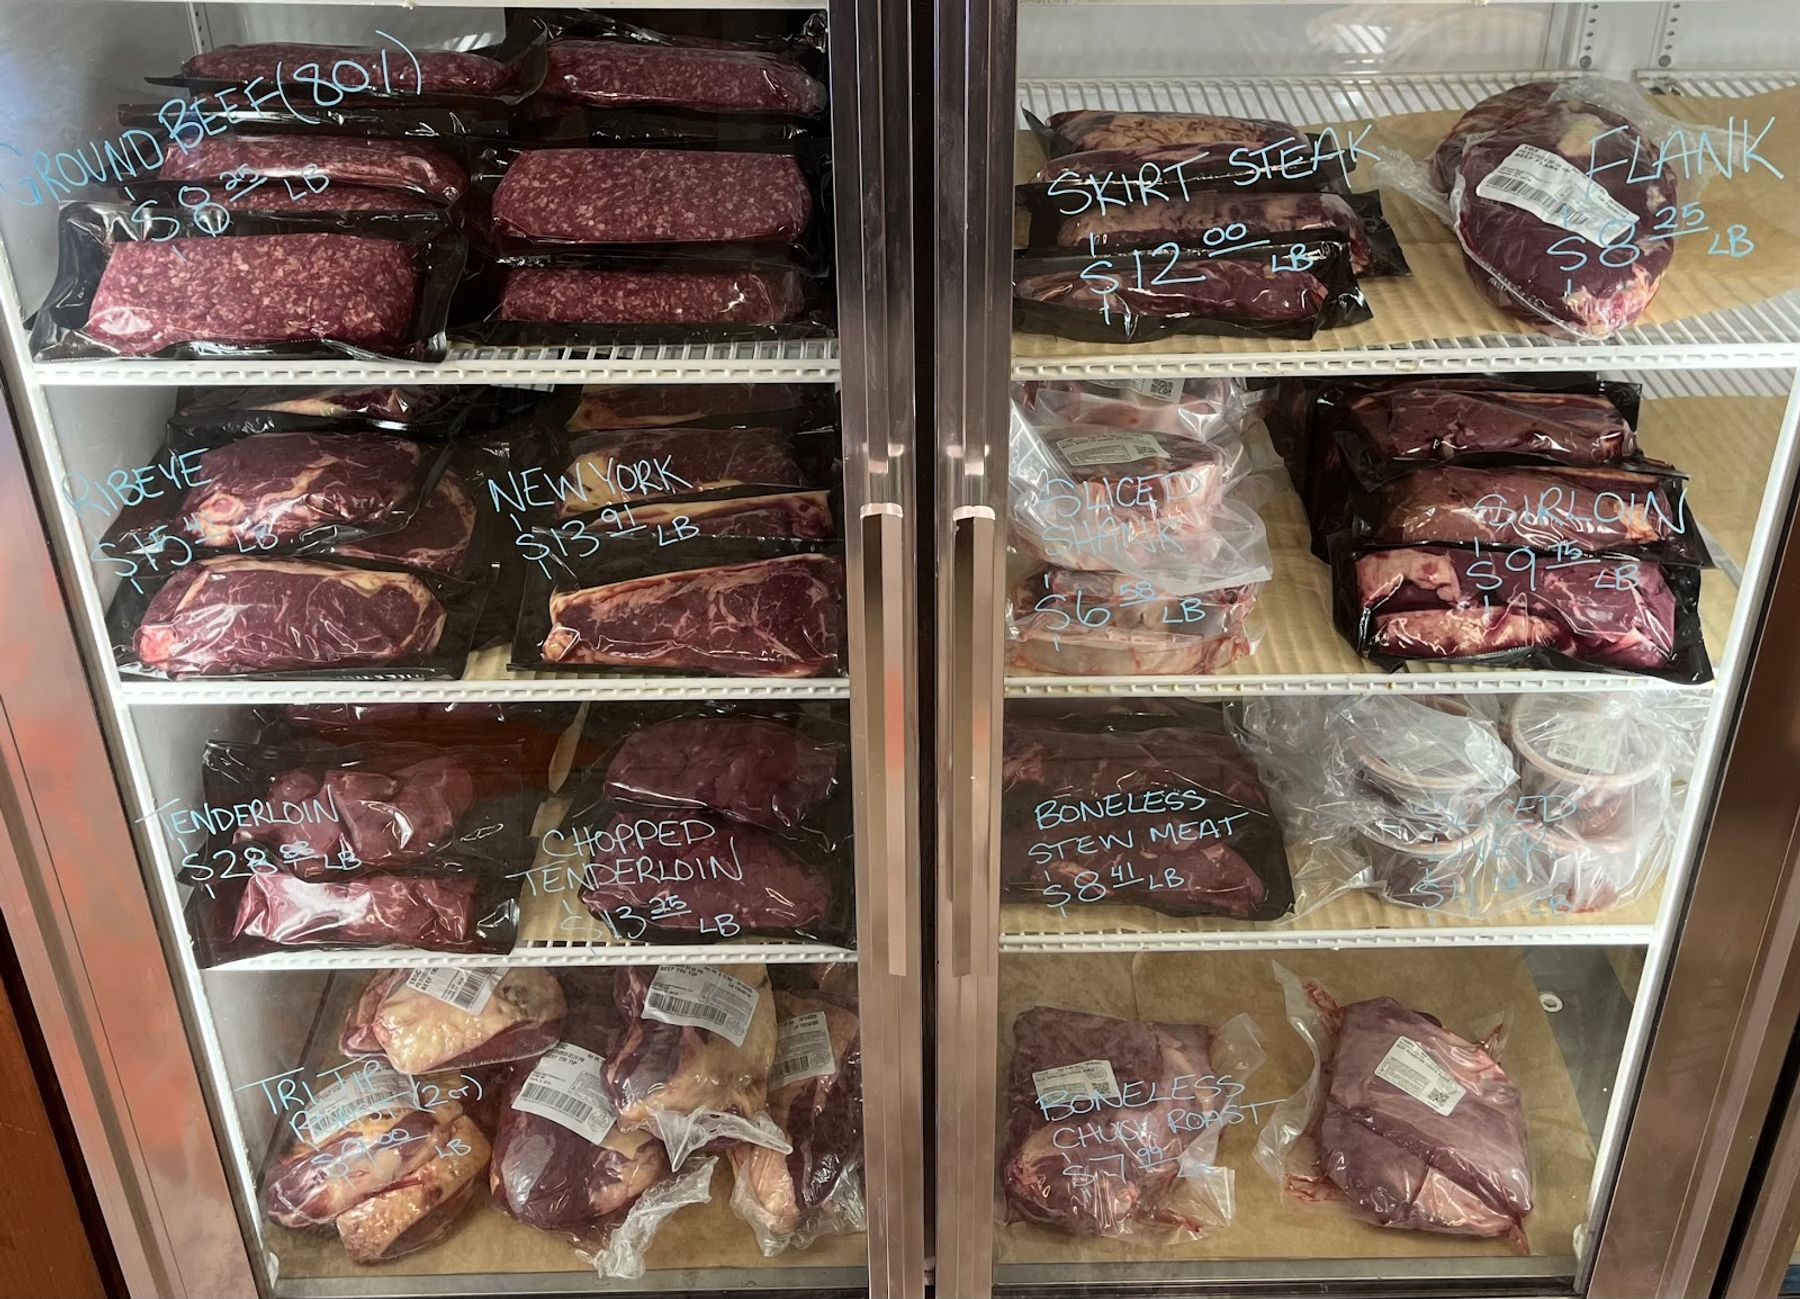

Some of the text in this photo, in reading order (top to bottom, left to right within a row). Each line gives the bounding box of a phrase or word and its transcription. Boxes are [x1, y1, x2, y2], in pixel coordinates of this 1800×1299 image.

[0, 129, 163, 208] GROUND
[1047, 124, 1381, 216] SKIRT STEAK
[1585, 116, 1784, 200] FLANK
[284, 163, 330, 200] LB
[1271, 243, 1315, 273] LB
[1708, 224, 1754, 258] LB
[62, 448, 212, 518] RIBEYE
[488, 454, 694, 513] NEW YORK
[1039, 471, 1202, 518] SLICED
[1474, 487, 1688, 534] SIRLOIN
[235, 522, 278, 553] LB
[656, 515, 701, 547] LB
[1041, 516, 1184, 556] SHANK
[1594, 563, 1640, 591] LB
[1162, 598, 1206, 624] LB
[135, 785, 340, 841] TENDERLOIN
[1034, 790, 1206, 830] BONELESS
[542, 819, 716, 857] CHOPPED
[1028, 812, 1250, 864] STEW MEAT
[324, 851, 362, 870] LB
[505, 837, 743, 896] TENDERLOIN
[1149, 868, 1184, 889] LB
[700, 914, 741, 937] LB
[235, 1067, 317, 1114] TRI
[316, 1054, 385, 1095] TIP
[1035, 1074, 1245, 1122] BONELESS
[1053, 1098, 1287, 1149] CHUCK ROAST
[435, 1138, 472, 1158] LB
